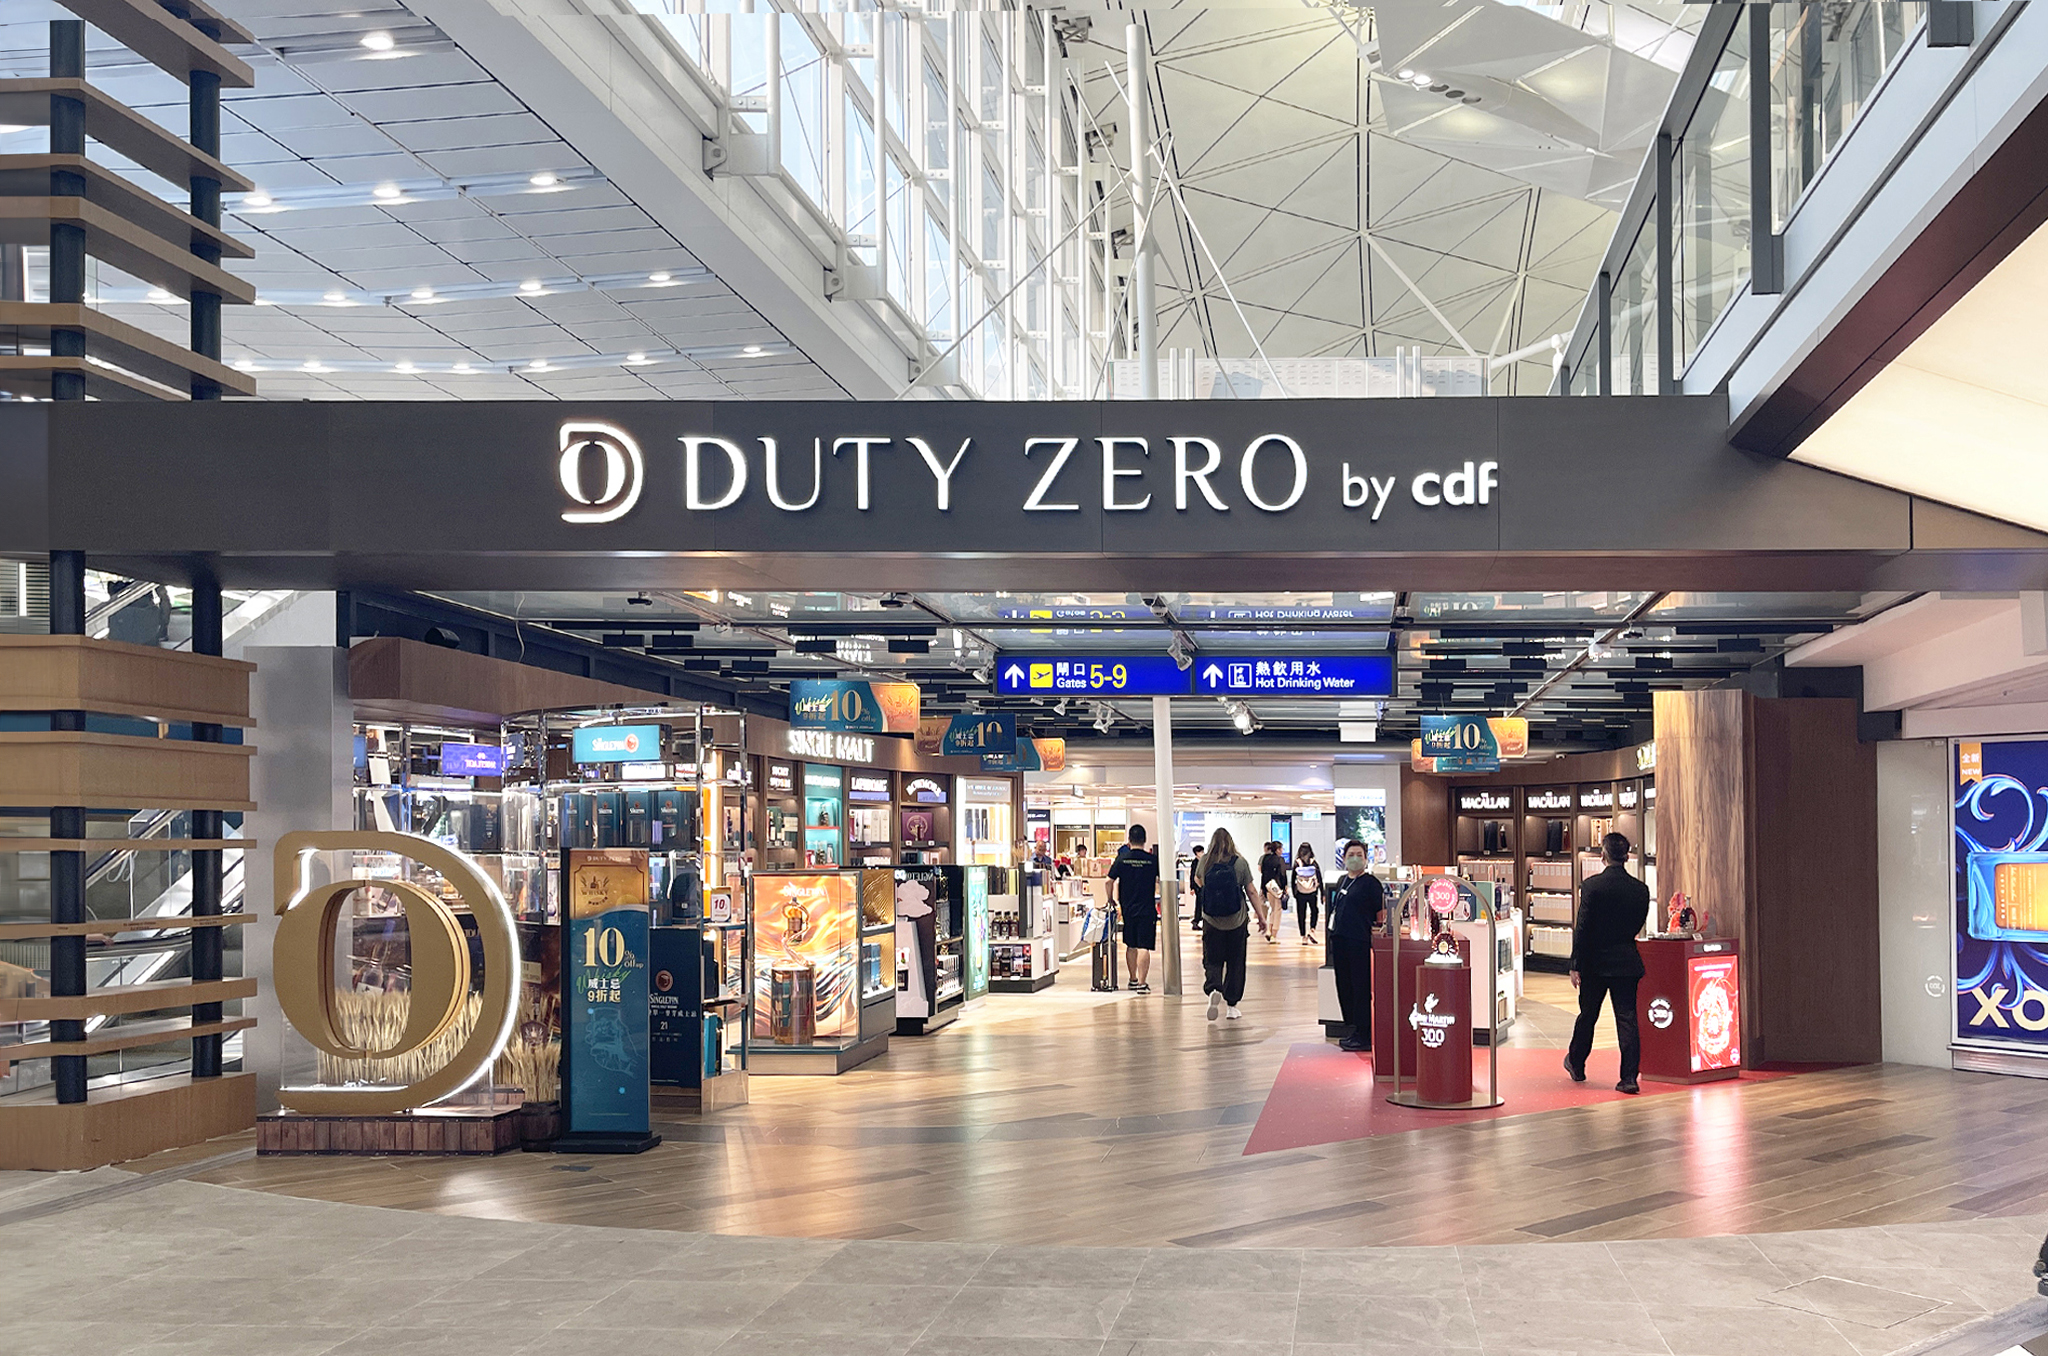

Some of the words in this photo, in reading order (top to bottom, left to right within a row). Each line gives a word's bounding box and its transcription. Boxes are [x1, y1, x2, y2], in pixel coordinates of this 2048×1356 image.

[677, 436, 972, 511] DUTY
[1022, 433, 1308, 512] ZERO
[1342, 463, 1396, 521] by
[1411, 461, 1498, 506] cdf
[1056, 677, 1087, 688] Gates
[1089, 664, 1127, 688] 5-9
[1255, 661, 1321, 676] 熱飲用水
[1255, 677, 1274, 688] Hot
[1277, 677, 1321, 690] Drinking
[1323, 677, 1355, 688] Water
[831, 689, 862, 721] 10
[976, 721, 1003, 748] 10
[1452, 723, 1481, 749] 10
[787, 730, 834, 758] SINGLE
[835, 735, 874, 763] MALT
[1961, 753, 1980, 763] 全新
[1434, 891, 1451, 900] 300
[583, 927, 625, 967] 10
[587, 978, 620, 989] 威士忌
[587, 989, 620, 1003] 9折起
[1968, 986, 2048, 1031] XO
[660, 1021, 668, 1030] 21
[1421, 1028, 1445, 1043] 300
